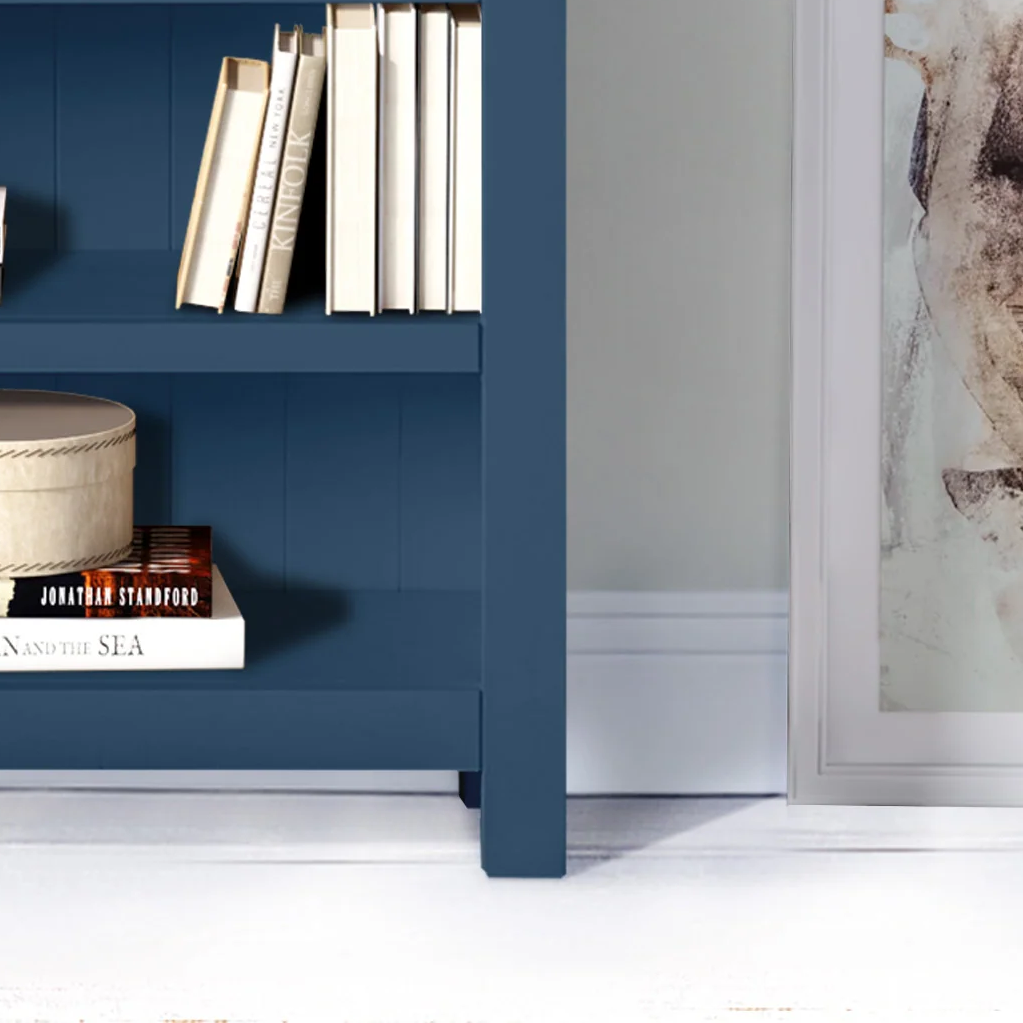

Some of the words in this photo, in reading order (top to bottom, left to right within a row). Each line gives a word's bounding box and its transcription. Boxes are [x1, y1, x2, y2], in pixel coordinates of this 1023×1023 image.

[274, 89, 286, 117] YORK
[269, 122, 280, 148] NEW
[252, 160, 277, 230] CEREAL
[272, 129, 311, 251] KINFOLK
[40, 586, 112, 606] JONATHAN
[118, 587, 199, 607] STANDFORD
[22, 641, 56, 656] AND
[59, 641, 91, 656] THE
[98, 633, 145, 657] SEA
